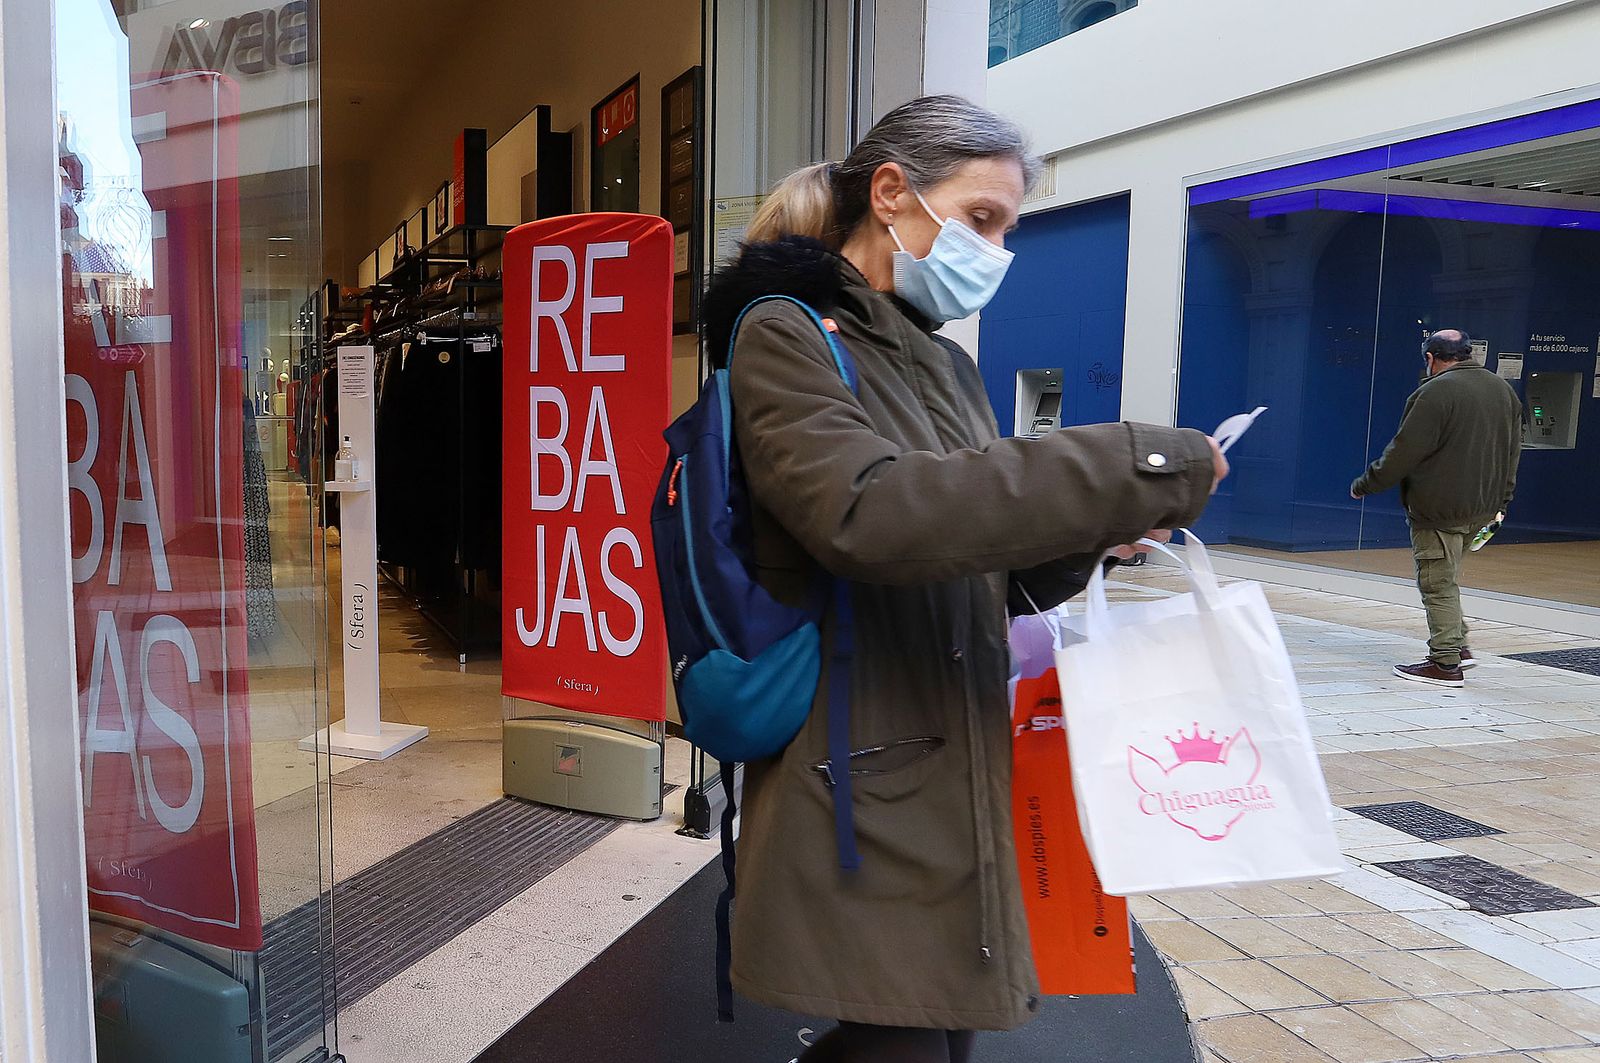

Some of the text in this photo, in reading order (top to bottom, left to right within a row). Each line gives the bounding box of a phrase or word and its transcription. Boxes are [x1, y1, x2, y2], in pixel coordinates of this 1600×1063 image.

[529, 240, 630, 373] RE
[1530, 333, 1536, 341] A
[1543, 334, 1566, 342] servicio
[1542, 344, 1551, 352] de
[1551, 344, 1569, 352] 6.000
[1569, 345, 1590, 354] cajeros
[529, 385, 627, 516] BA
[515, 524, 645, 658] JAS
[83, 610, 206, 834] AS
[1027, 795, 1051, 900] www.dospies.es
[1138, 784, 1272, 816] Chiguagua
